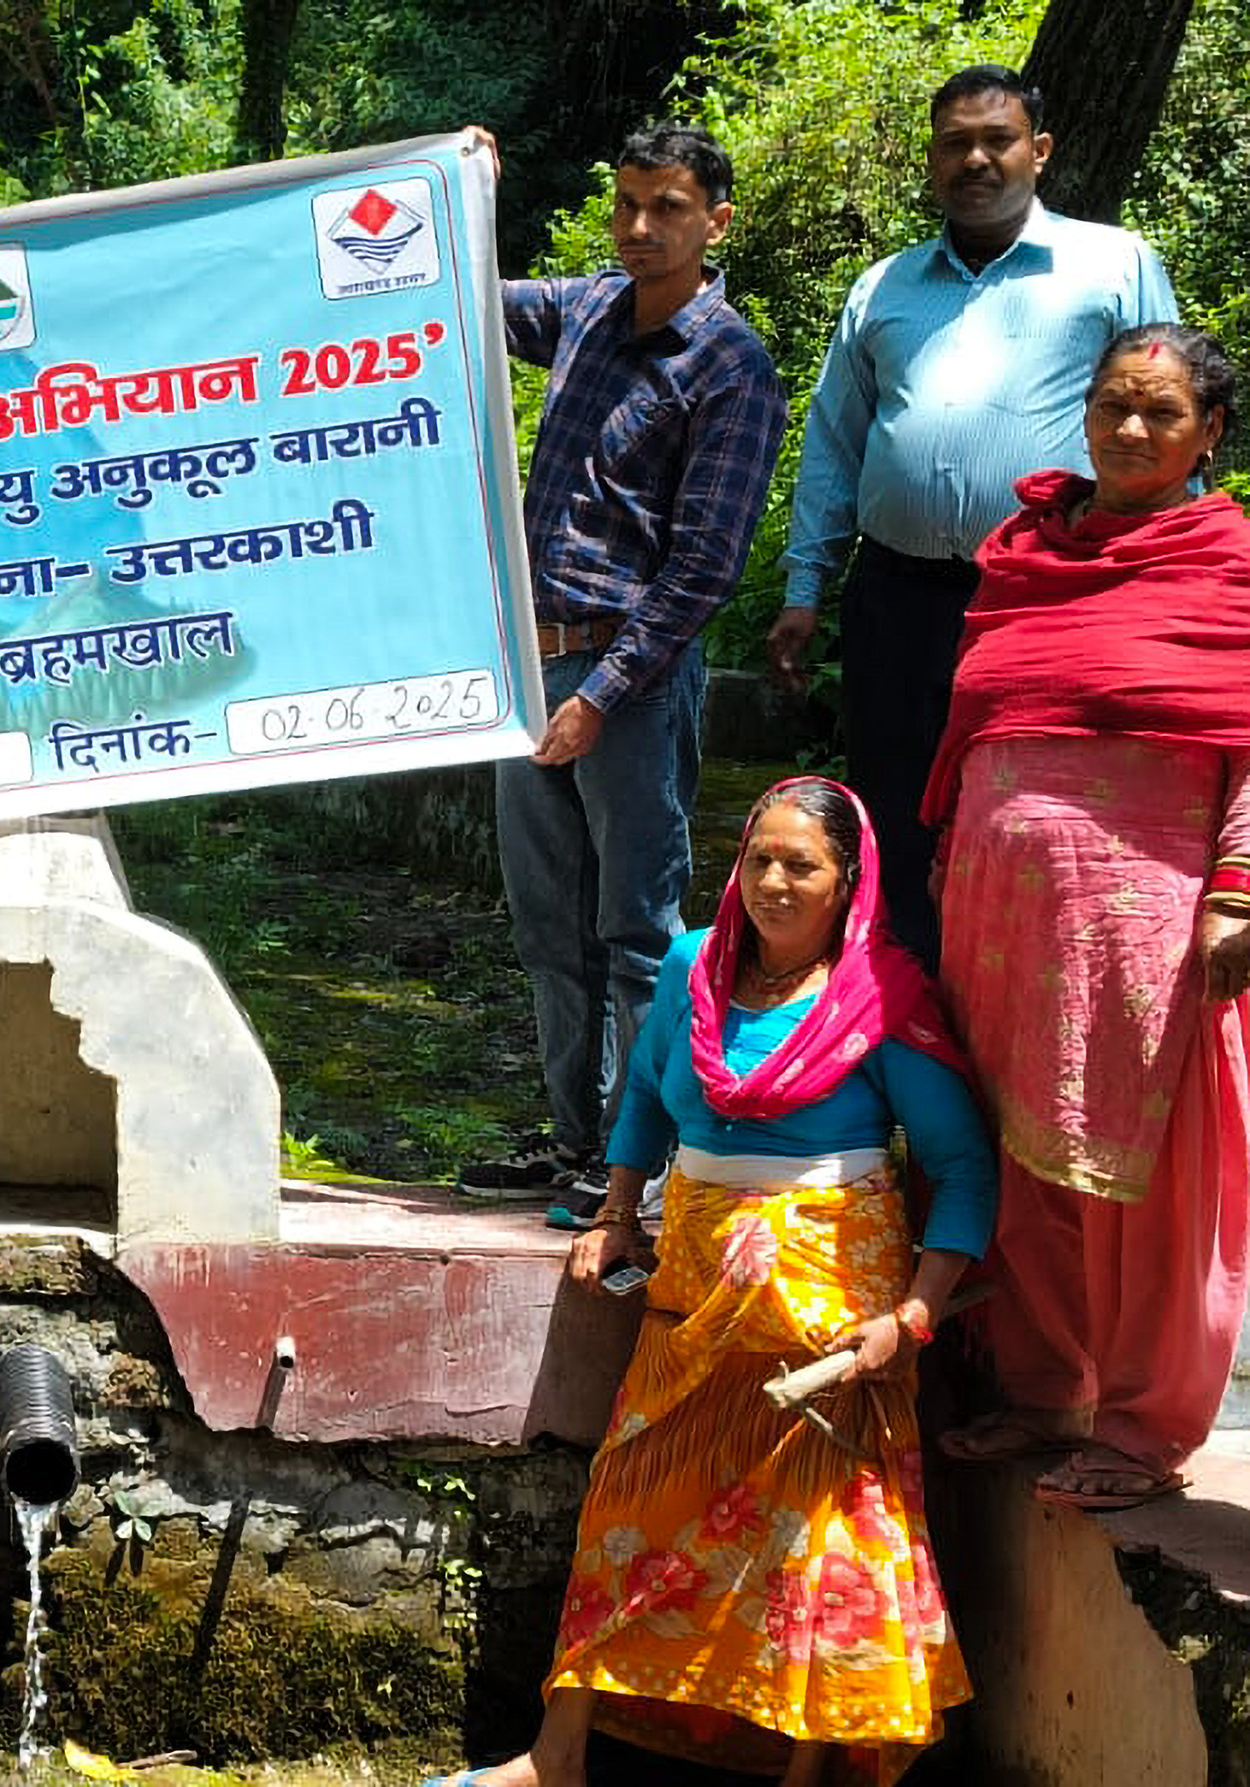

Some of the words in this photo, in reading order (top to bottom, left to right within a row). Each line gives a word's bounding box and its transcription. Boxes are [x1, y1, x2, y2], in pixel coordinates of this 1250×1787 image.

[50, 437, 258, 509] अनुकूल
[271, 397, 442, 464] बारानी
[107, 498, 376, 584] उत्तरकाशी
